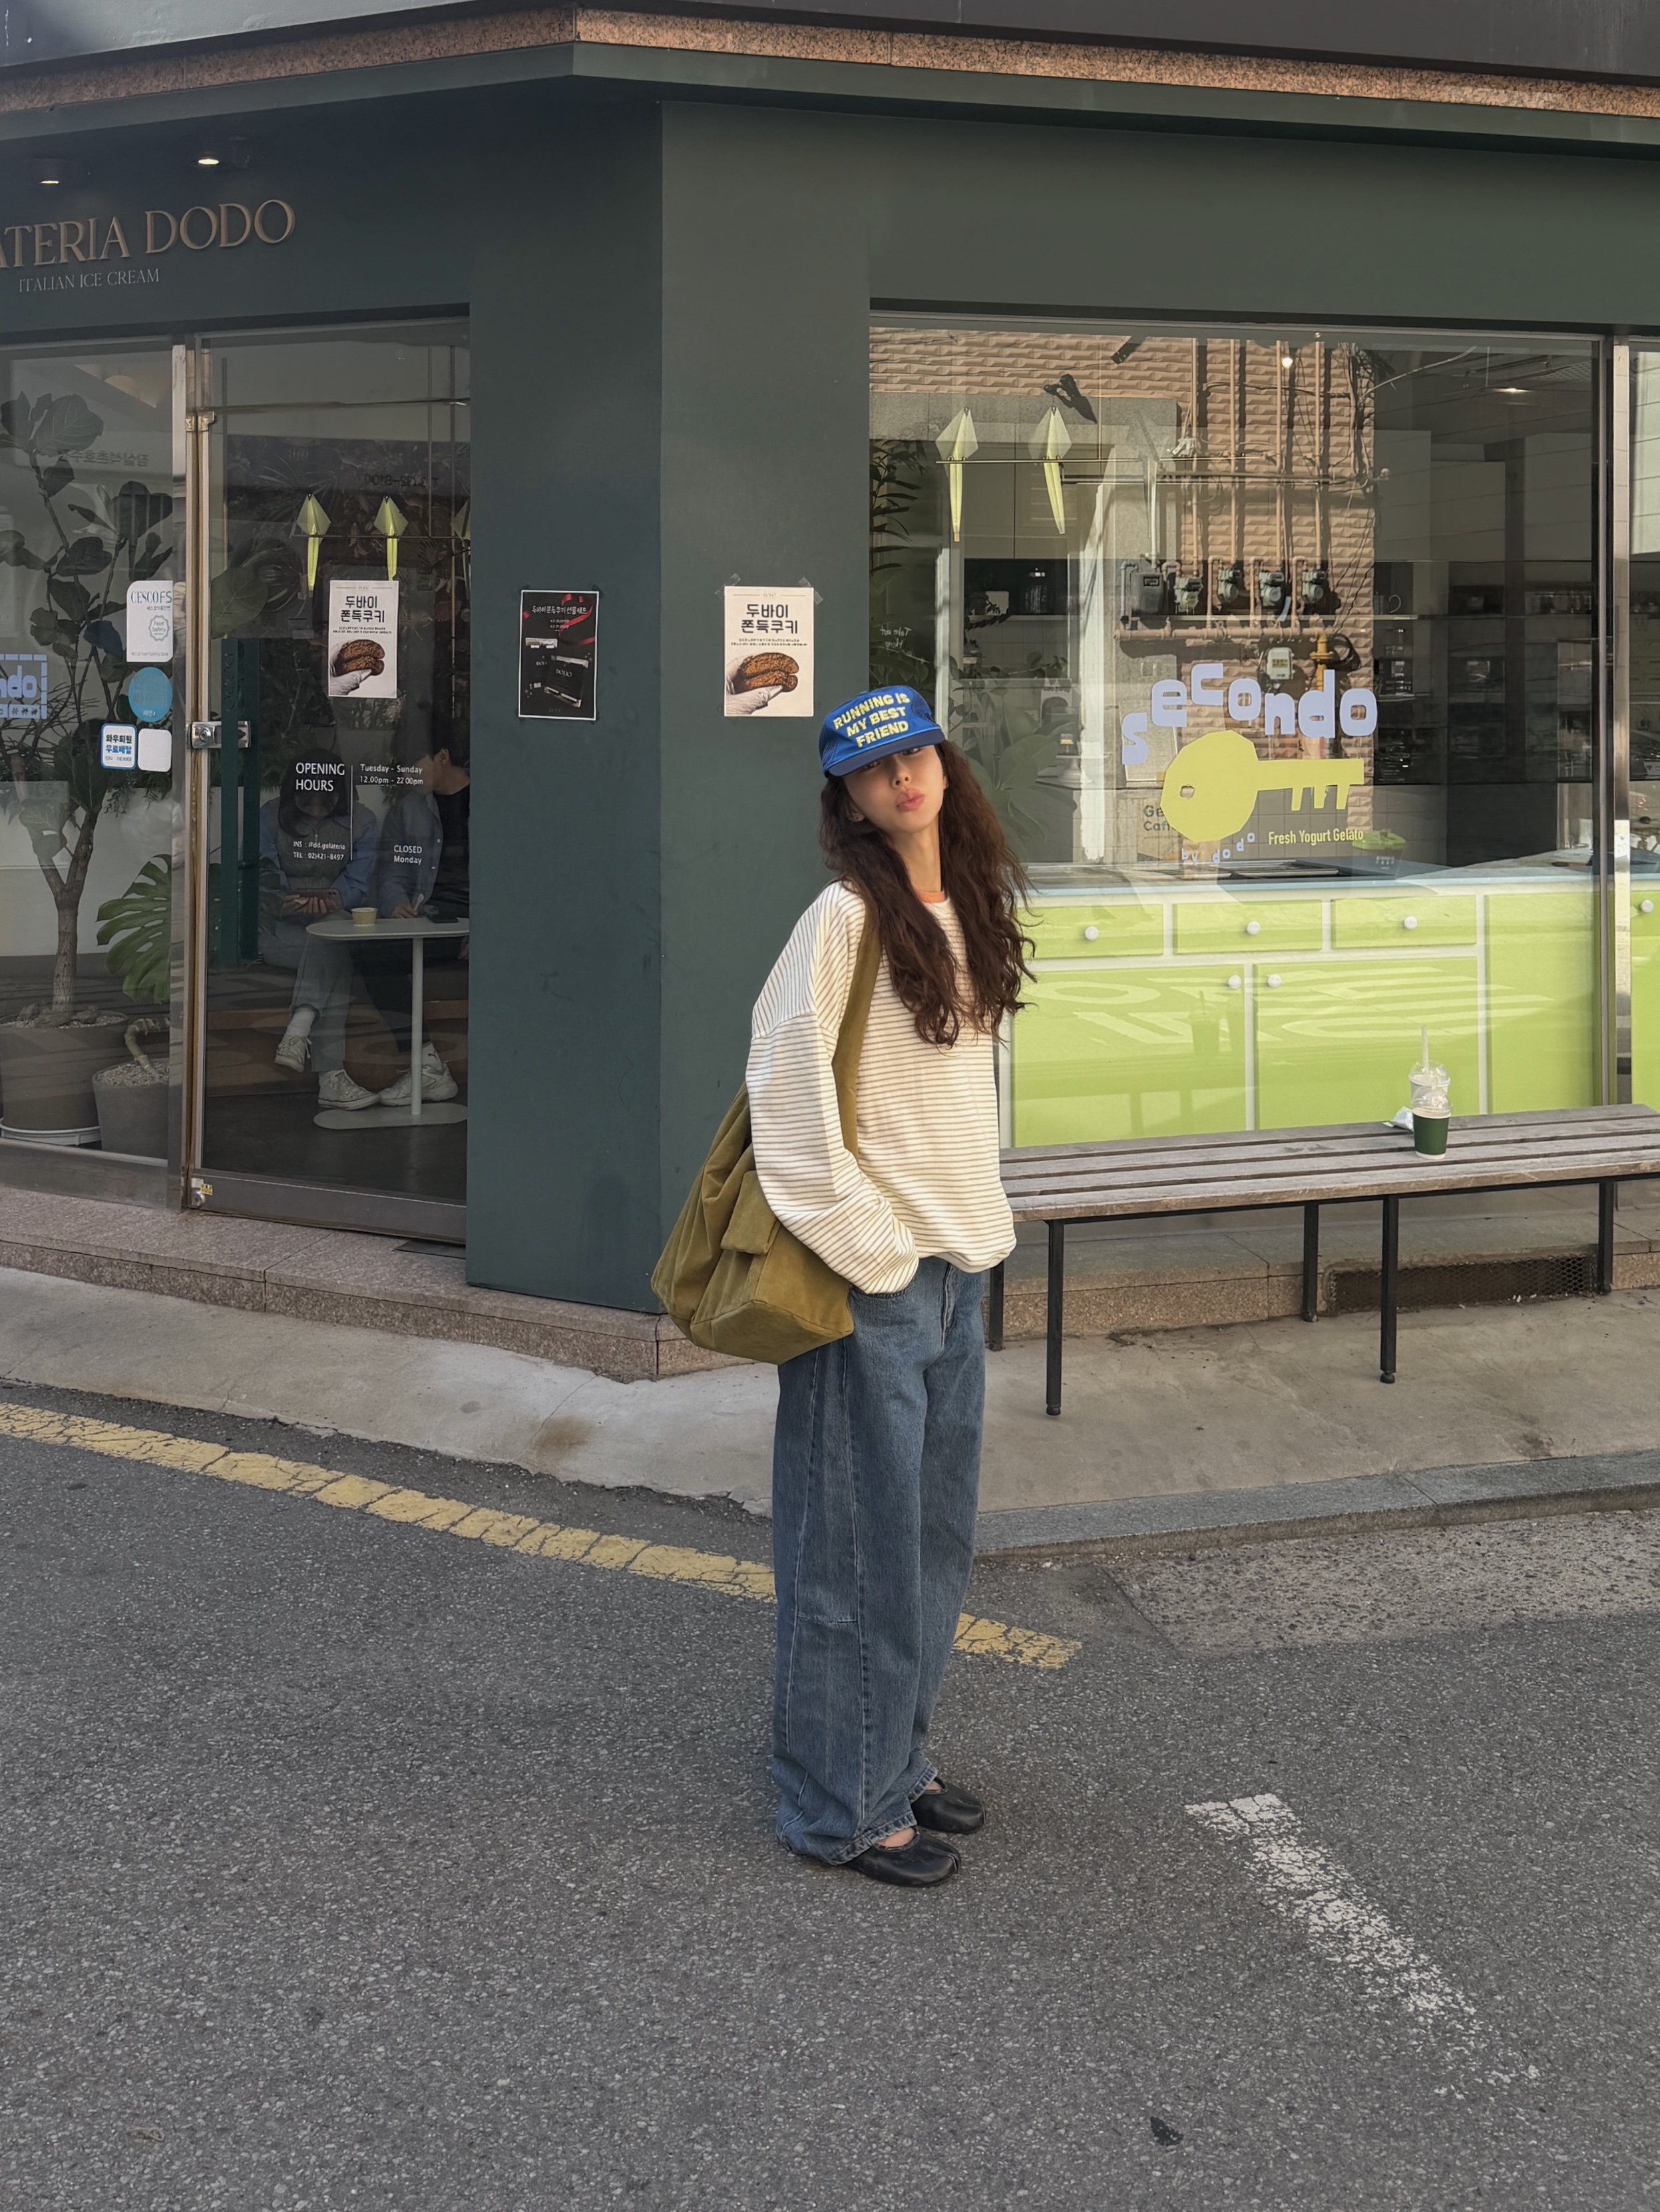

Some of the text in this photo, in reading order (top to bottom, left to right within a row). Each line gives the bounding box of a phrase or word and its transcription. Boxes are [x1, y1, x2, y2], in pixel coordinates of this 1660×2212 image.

[145, 199, 296, 254] DODO
[19, 268, 160, 293] ITALIAN ICE CREAM
[345, 596, 377, 608] 두바이
[341, 610, 385, 622] 쫀득쿠키
[746, 604, 788, 618] 두바이
[741, 619, 798, 634] 쫀득쿠키
[833, 693, 911, 730] RUNNING IS
[1122, 663, 1378, 765] secondo
[846, 706, 906, 738] MY BEST
[855, 720, 909, 748] FRIEND
[296, 762, 345, 775] OPENING
[359, 764, 389, 774] Tuesday
[396, 765, 423, 775] Sunday
[296, 779, 334, 791] HOURS
[1143, 805, 1165, 817] Ge
[1268, 827, 1364, 846] Fresh Yogurt Gelato
[393, 845, 423, 854] CLOSED
[393, 855, 423, 865] Monday
